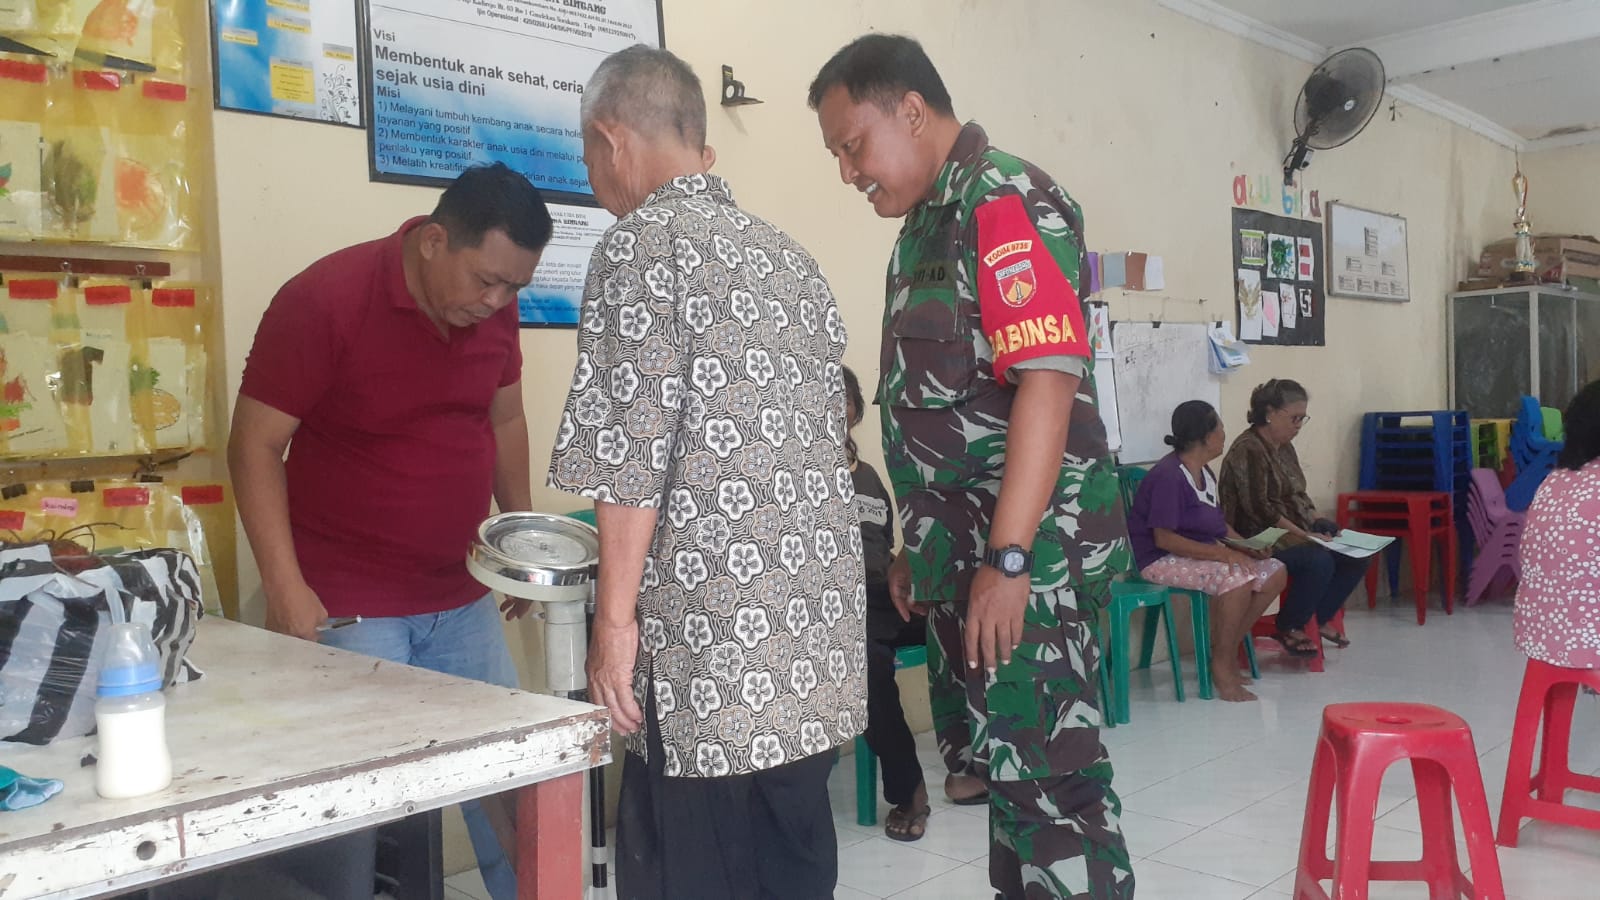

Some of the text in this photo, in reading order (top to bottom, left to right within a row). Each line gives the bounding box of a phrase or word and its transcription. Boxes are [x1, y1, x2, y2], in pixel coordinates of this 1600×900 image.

[373, 28, 396, 42] Visi
[375, 44, 583, 94] Membentuk anak sehat, ceria
[376, 69, 486, 96] sejak usia dini
[376, 85, 400, 99] Misi
[377, 114, 471, 135] layanan yang positif
[378, 101, 584, 139] 1) Melayani tumbuh kembang anak secara holis
[378, 127, 388, 139] 2)
[391, 129, 446, 145] Membentuk
[448, 136, 485, 150] karakter
[487, 142, 509, 153] anak
[510, 146, 528, 156] usia
[529, 148, 545, 158] dini
[546, 150, 575, 161] melalui
[420, 147, 442, 159] yang
[379, 155, 389, 166] 3)
[392, 155, 427, 168] Melatih
[547, 175, 568, 185] anak
